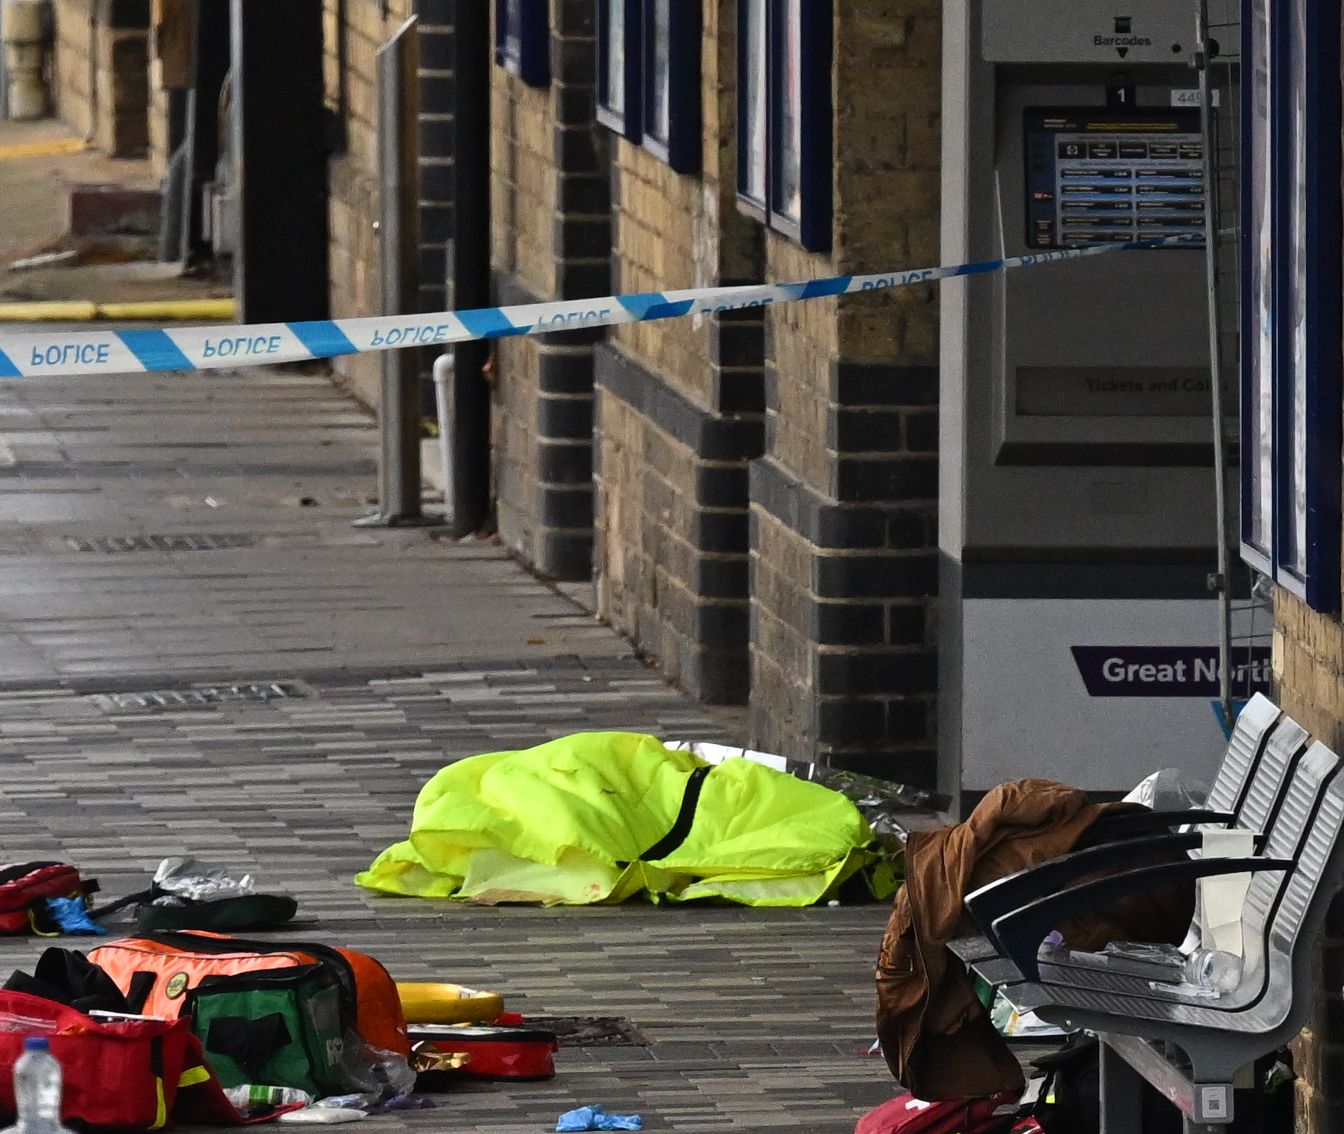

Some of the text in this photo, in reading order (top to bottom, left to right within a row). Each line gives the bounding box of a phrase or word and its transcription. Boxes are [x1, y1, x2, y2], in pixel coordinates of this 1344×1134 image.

[1094, 35, 1151, 46] Barcodes
[1117, 88, 1126, 103] 1
[1086, 378, 1143, 392] Tickets
[1148, 378, 1177, 392] and
[1102, 657, 1187, 683] Great
